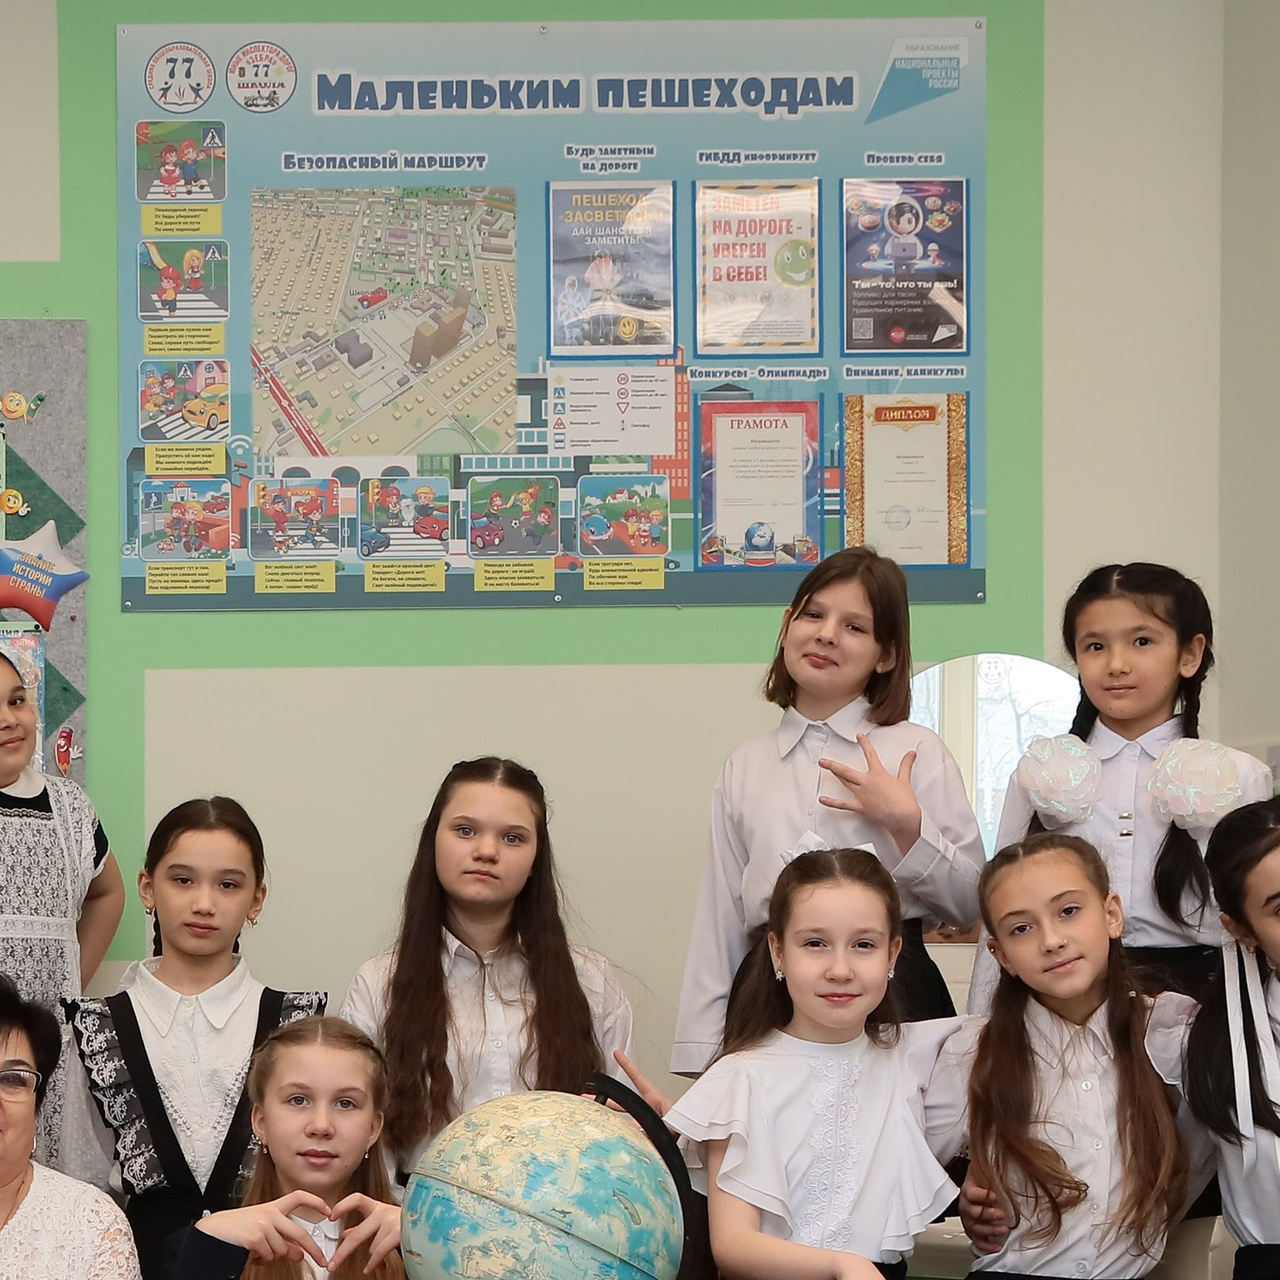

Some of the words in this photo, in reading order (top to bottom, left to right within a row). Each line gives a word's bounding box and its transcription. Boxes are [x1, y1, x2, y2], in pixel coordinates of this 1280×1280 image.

[242, 45, 280, 60] ИНСПЕКТОРА
[165, 57, 195, 79] 77
[895, 58, 959, 69] НАЦИОНАЛЬНЫЕ
[252, 64, 270, 77] 77
[922, 69, 959, 78] ПРОЕКТЫ
[928, 78, 958, 88] РОССИИ
[698, 151, 742, 164] ГИБДД
[572, 226, 592, 236] ДАЙ
[595, 227, 626, 235] ШАНС
[713, 220, 732, 235] НА
[736, 219, 793, 237] ДОРОГЕ
[585, 236, 640, 245] ЗАМЕТИТЬ!
[713, 243, 766, 258] УВЕРЕН
[713, 266, 722, 281] В
[727, 266, 768, 282] СЕБЕ!
[881, 410, 930, 421] ДИПЛОМ
[730, 419, 788, 429] ГРАМОТА
[19, 552, 56, 573] ЗНАНИЕ
[12, 563, 53, 586] ИСТОРИИ
[9, 576, 46, 598] СТРАНЫ
